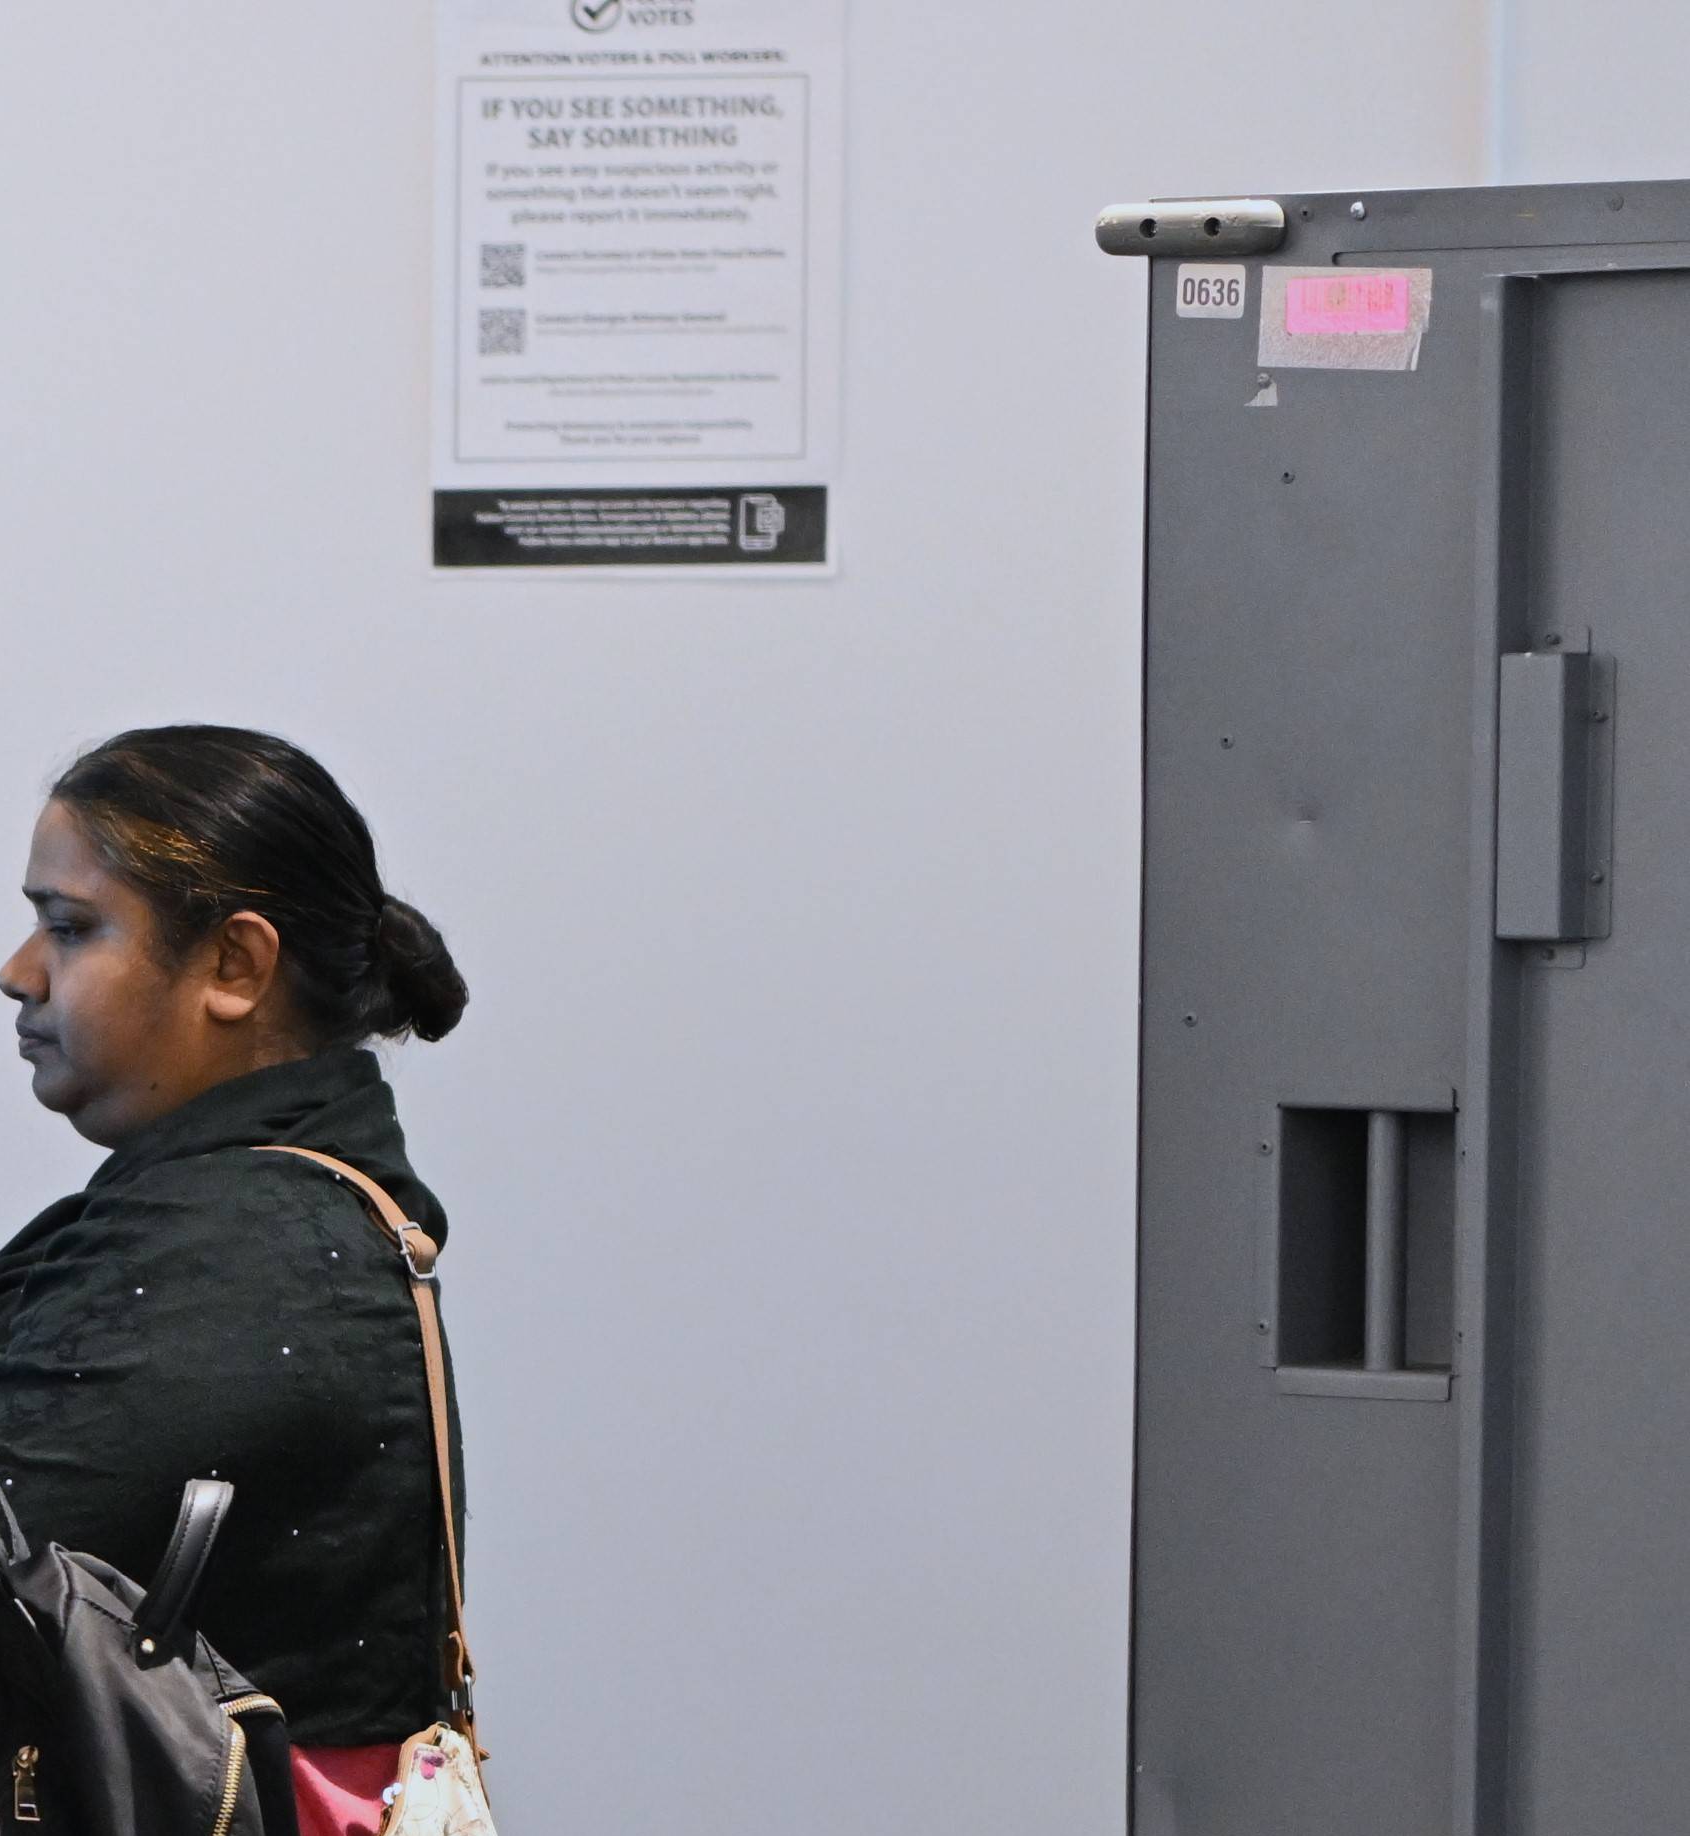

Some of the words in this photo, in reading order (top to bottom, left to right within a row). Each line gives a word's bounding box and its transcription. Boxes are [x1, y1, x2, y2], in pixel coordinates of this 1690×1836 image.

[627, 10, 694, 26] VOTES
[481, 98, 503, 120] IF
[510, 98, 564, 120] YOU
[571, 97, 614, 119] SEE
[528, 126, 574, 148] SAY
[582, 124, 738, 148] SOMETHING
[1182, 278, 1240, 307] 0636
